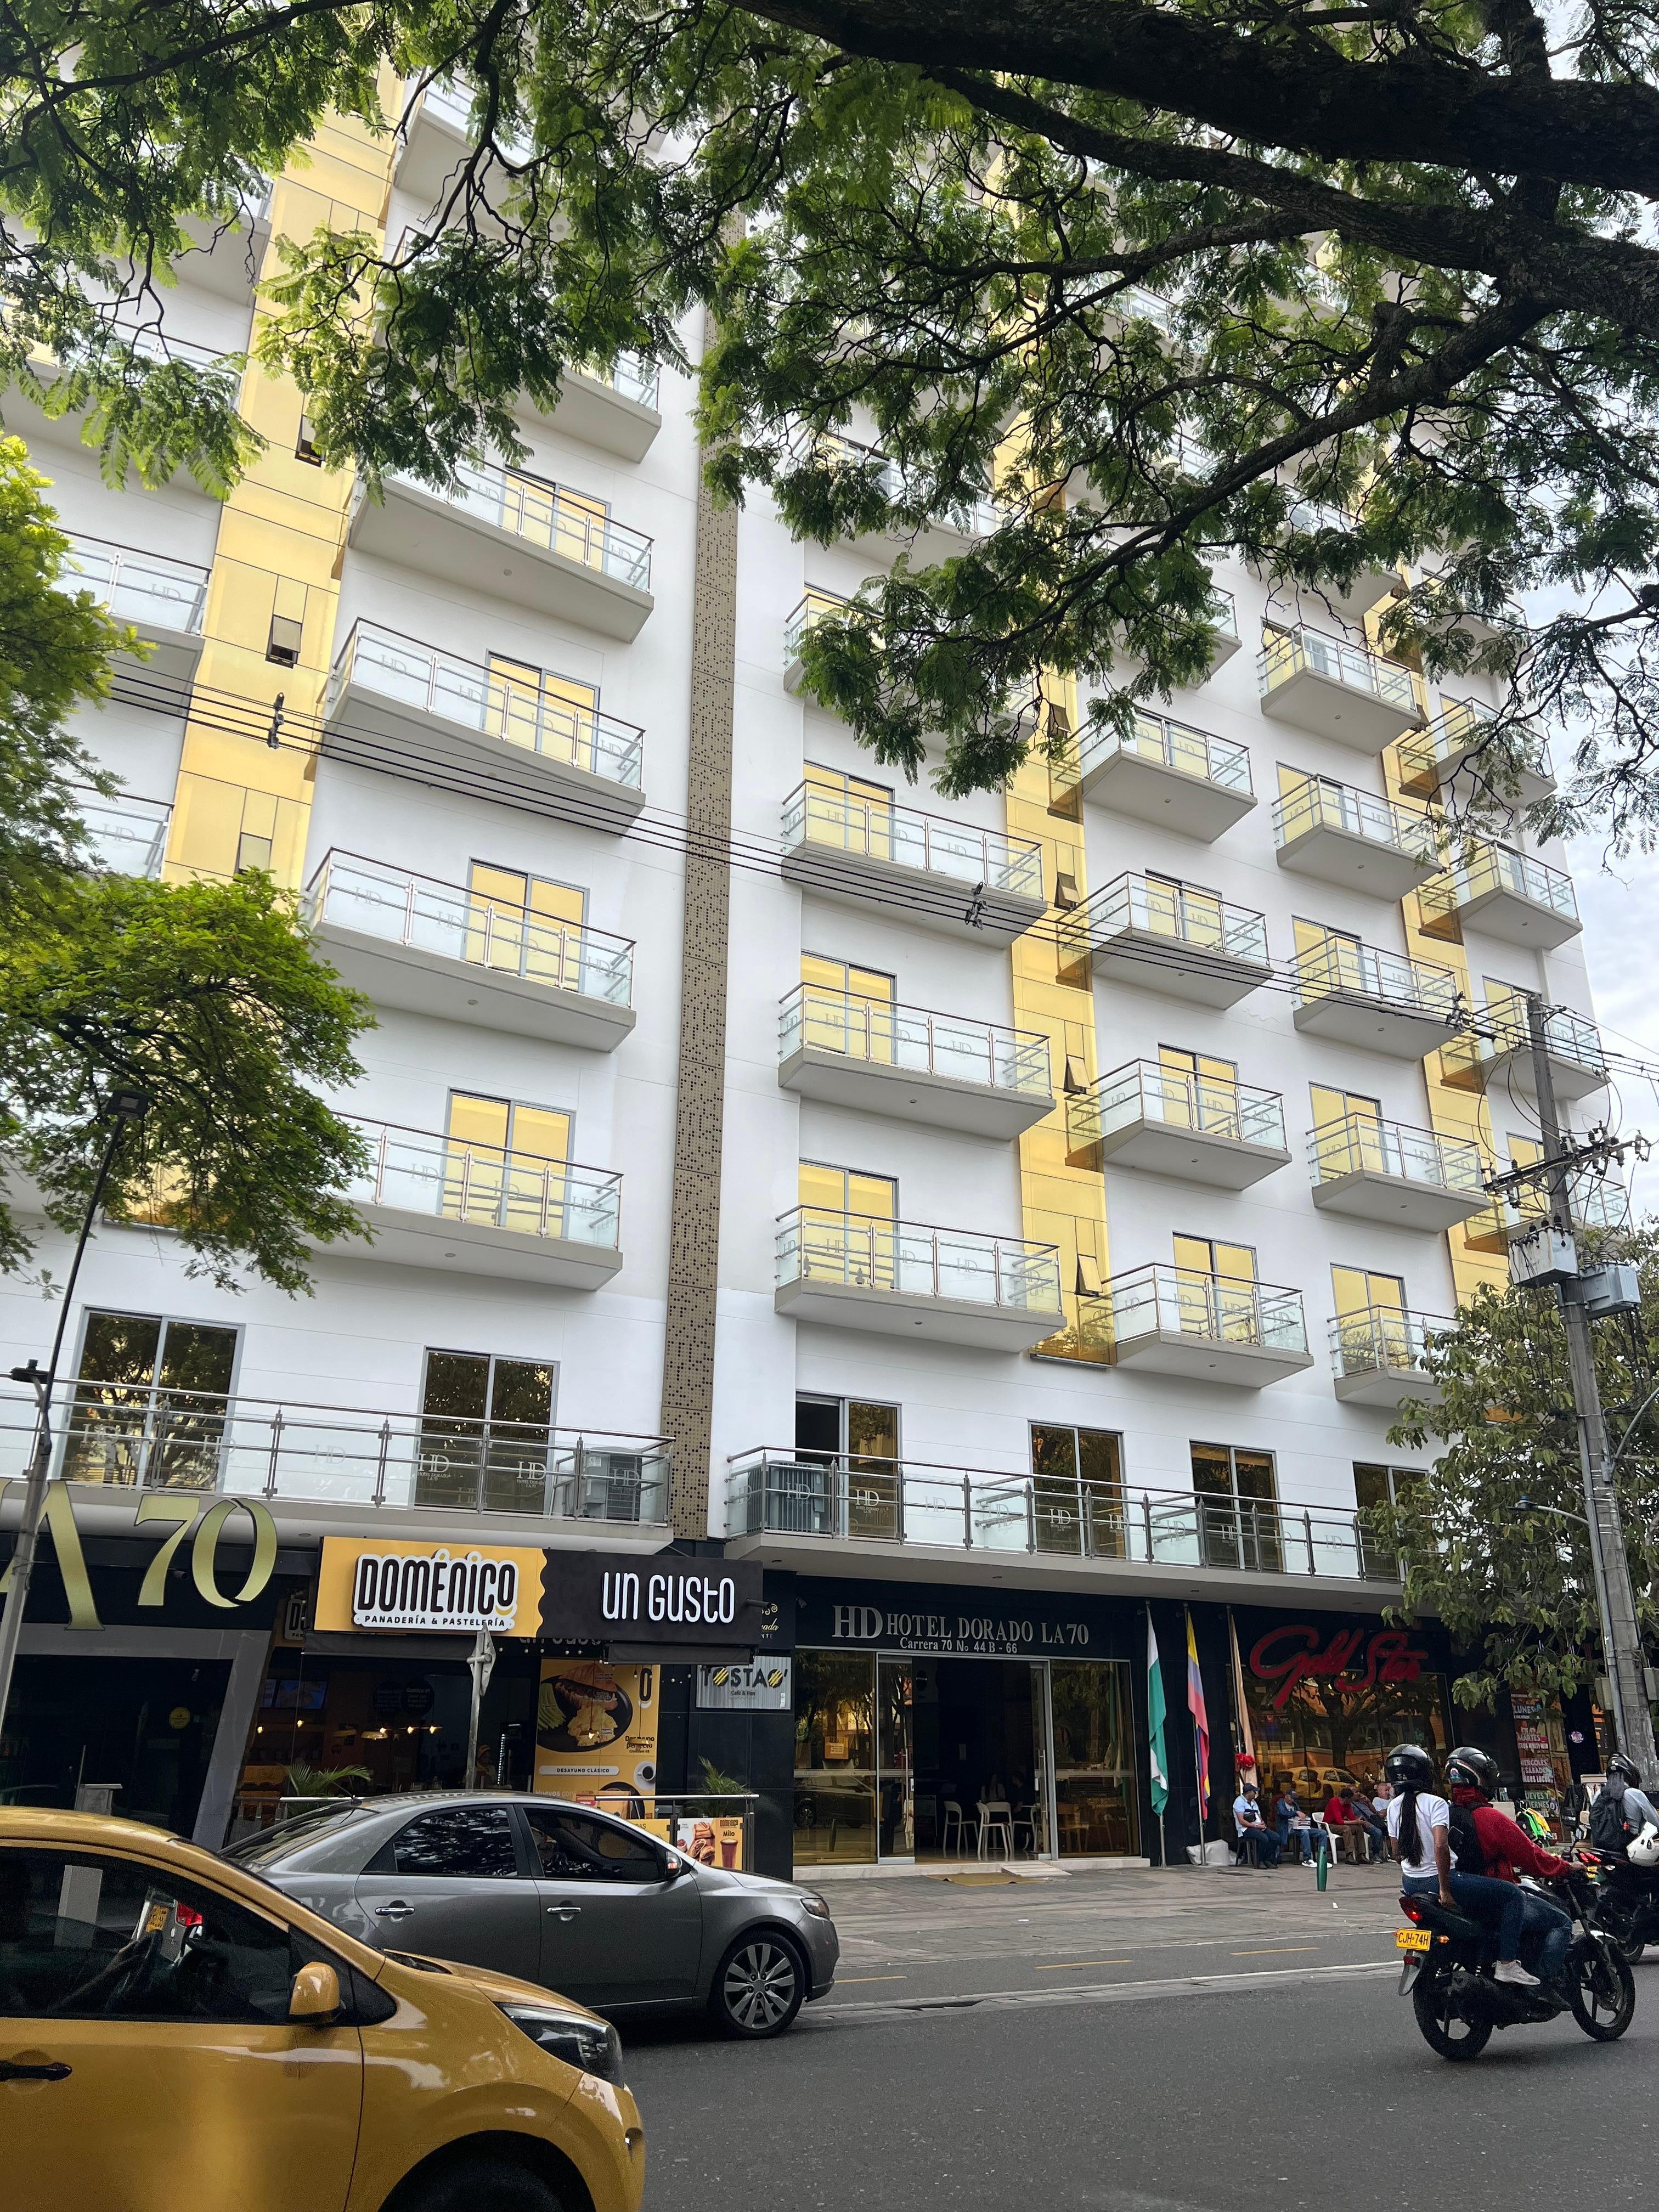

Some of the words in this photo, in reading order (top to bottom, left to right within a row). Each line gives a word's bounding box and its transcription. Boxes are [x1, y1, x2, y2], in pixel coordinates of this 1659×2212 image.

[418, 1453, 450, 1473] HD
[517, 1460, 546, 1480] HD
[855, 1489, 879, 1506] HD
[1049, 1509, 1071, 1525] HD
[134, 1494, 277, 1608] 70
[365, 1615, 426, 1624] PANADERÍA
[831, 1605, 883, 1639] HD
[887, 1613, 952, 1638] HOTEL
[957, 1617, 1034, 1642] DORADO
[900, 1637, 939, 1650] Carrera
[941, 1640, 952, 1651] 70
[1006, 1642, 1018, 1654] 66
[1514, 1705, 1535, 1714] LUNES
[1516, 1733, 1541, 1741] MARTES
